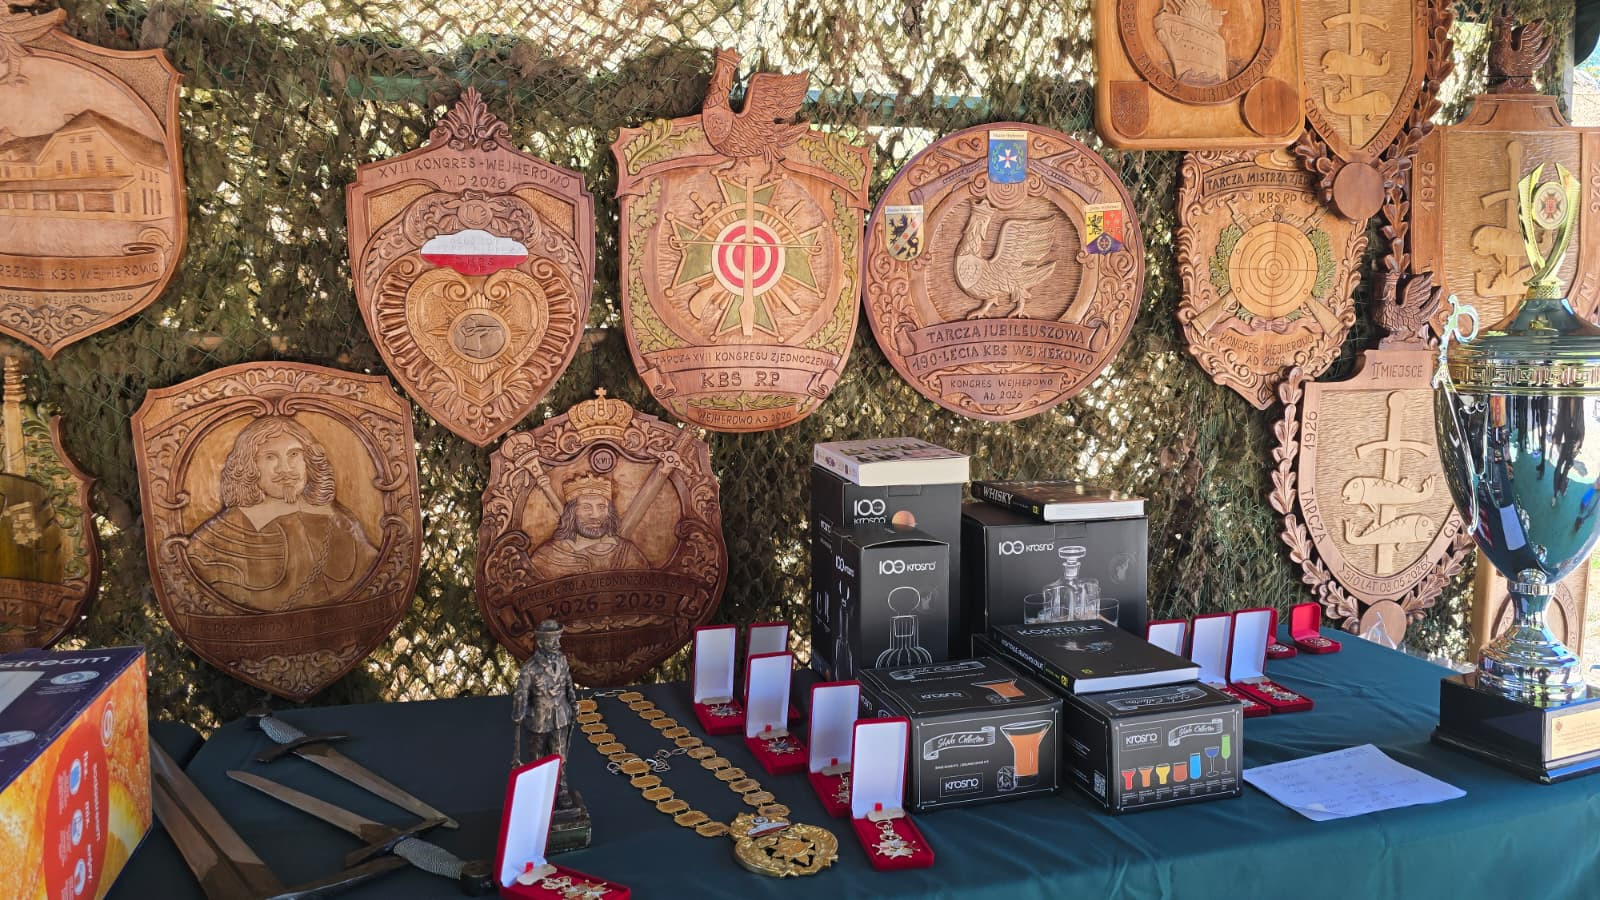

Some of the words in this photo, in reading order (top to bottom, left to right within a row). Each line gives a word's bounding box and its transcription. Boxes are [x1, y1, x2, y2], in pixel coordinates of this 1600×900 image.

[1136, 52, 1180, 94] TARCZA
[378, 163, 410, 179] XVII
[415, 156, 475, 171] KONGRES
[485, 158, 571, 189] WEJHEROWO
[469, 174, 507, 190] 2026
[1206, 176, 1244, 190] TARCZA
[1247, 172, 1287, 184] MISTRZA
[1421, 161, 1436, 213] 1926
[1258, 192, 1281, 204] KBS
[1283, 193, 1297, 205] RP
[111, 292, 134, 303] 2026
[927, 324, 980, 344] TARCZA
[983, 323, 1085, 344] JUBILEUSZOWA
[1218, 331, 1259, 353] KONGRES
[715, 351, 768, 363] KONGRESU
[912, 346, 979, 371] 190-LECIA
[982, 344, 1008, 358] KBS
[1013, 344, 1094, 366] WEJHEROWO
[1245, 355, 1259, 366] AD
[1263, 355, 1285, 367] 2026
[701, 372, 742, 388] KBS
[754, 371, 780, 388] RP
[1381, 365, 1423, 378] MIEJSCE
[950, 378, 992, 389] KONGRES
[998, 378, 1053, 389] WEJHEROWO
[983, 391, 996, 401] AD
[999, 389, 1023, 400] 2026
[697, 411, 753, 425] WEJHEROWO
[1303, 410, 1318, 451] 1926
[595, 457, 611, 465] XVII
[983, 486, 1014, 505] WHISKY
[854, 499, 886, 516] 100
[1301, 488, 1327, 545] TARCZA
[998, 540, 1025, 556] 100
[879, 559, 905, 575] 100
[1344, 570, 1361, 588] STO
[1360, 578, 1377, 592] LAT
[546, 597, 599, 620] 2026
[615, 591, 667, 610] 2029
[1125, 733, 1158, 745] krosno
[945, 777, 979, 791] krosno
